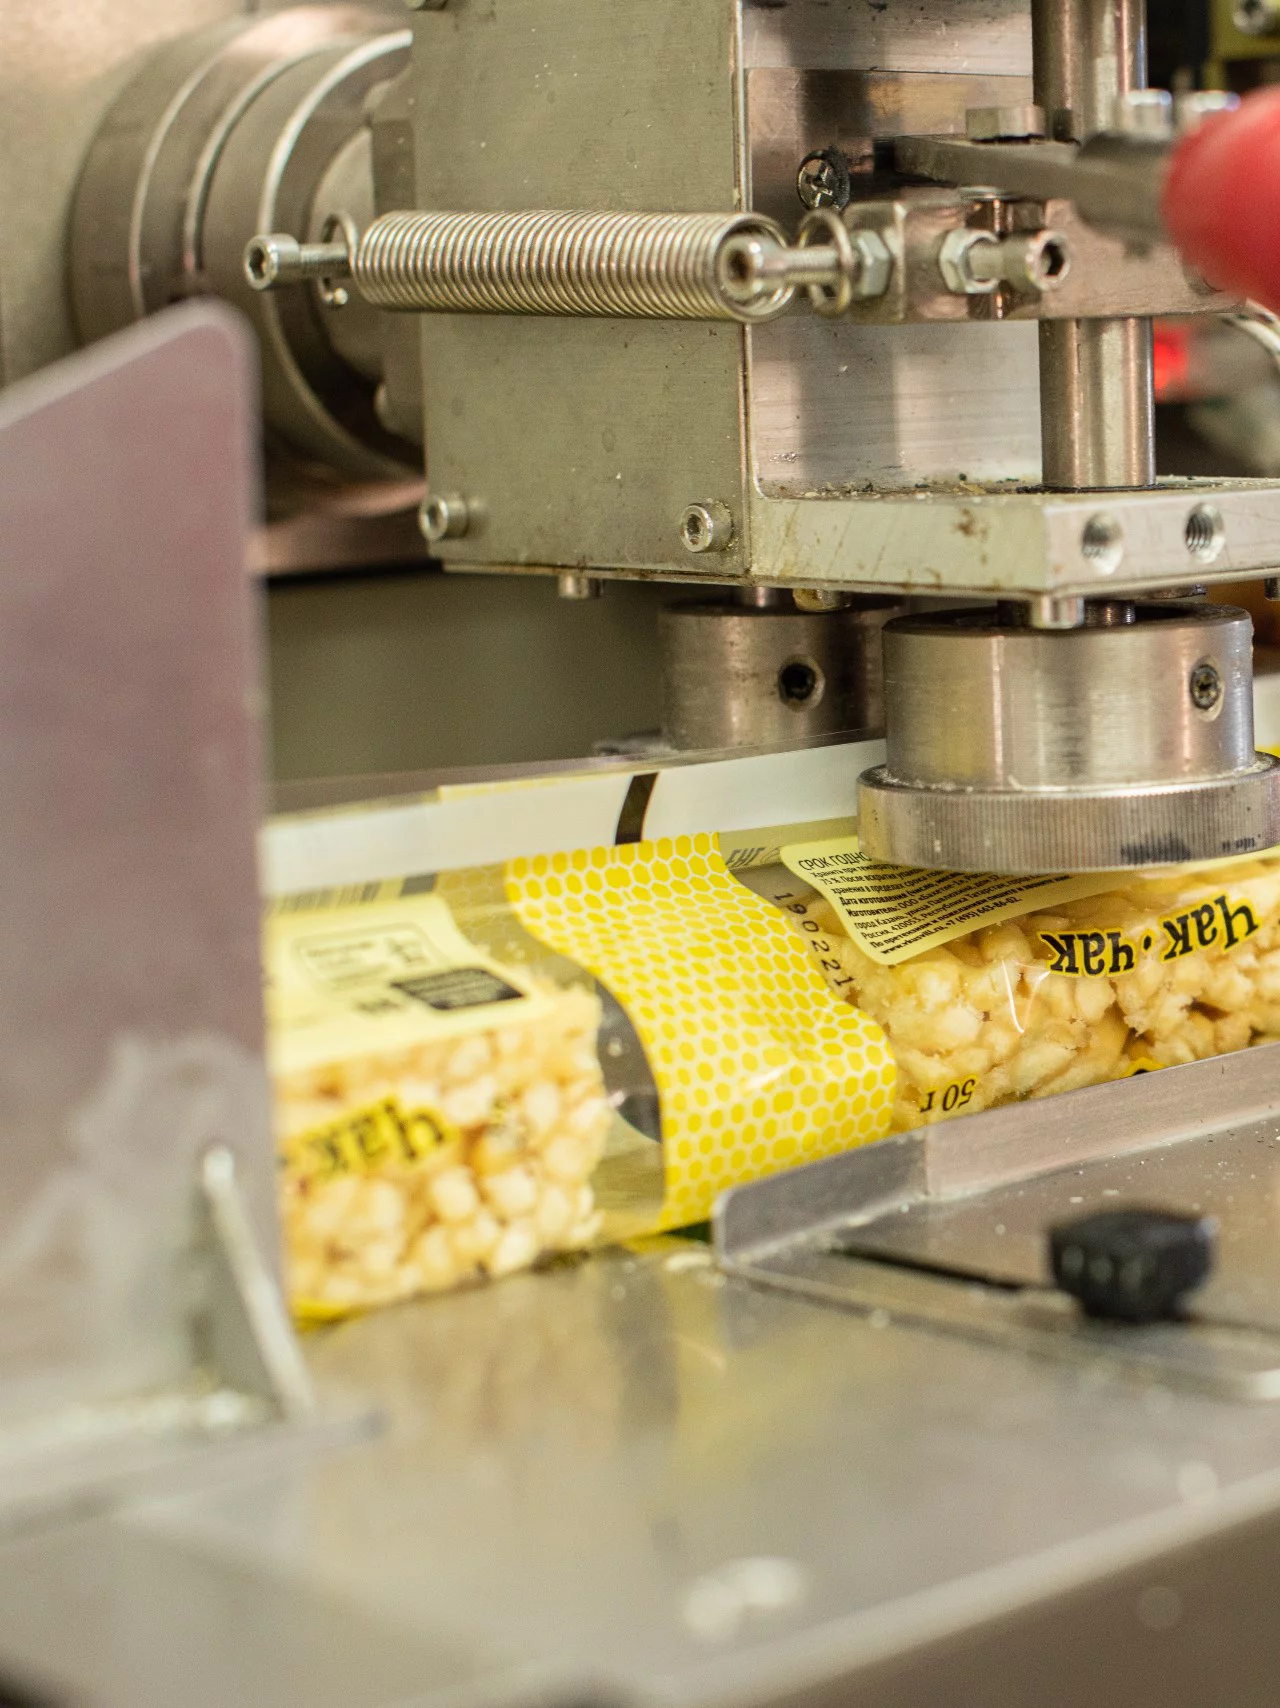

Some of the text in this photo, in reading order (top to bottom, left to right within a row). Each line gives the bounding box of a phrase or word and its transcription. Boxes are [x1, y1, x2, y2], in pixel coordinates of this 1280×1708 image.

[798, 851, 872, 870] СРОК ГОДНО
[810, 869, 844, 877] Хранить
[839, 874, 865, 882] После
[831, 886, 866, 895] хранения
[870, 883, 904, 893] пределах
[904, 875, 928, 887] срока
[839, 896, 859, 906] Дата
[858, 892, 908, 904] изготовления
[846, 905, 901, 917] Изготовитель:
[898, 898, 919, 909] ООО
[854, 921, 878, 930] город
[874, 915, 908, 926] Казань,
[904, 904, 930, 917] улица
[860, 930, 894, 940] Россия,
[890, 916, 925, 931] 420053,
[921, 897, 969, 919] Республика
[965, 883, 1009, 898] Татарстан,
[870, 941, 885, 949] По
[883, 922, 933, 944] претензиям
[937, 898, 988, 921] пожеланиям
[986, 888, 1018, 901] пишите
[945, 918, 956, 926] +7
[954, 910, 980, 923] (495)
[774, 892, 856, 987] 190221
[1041, 894, 1260, 975] Чак чак
[919, 1078, 976, 1113] 50 г
